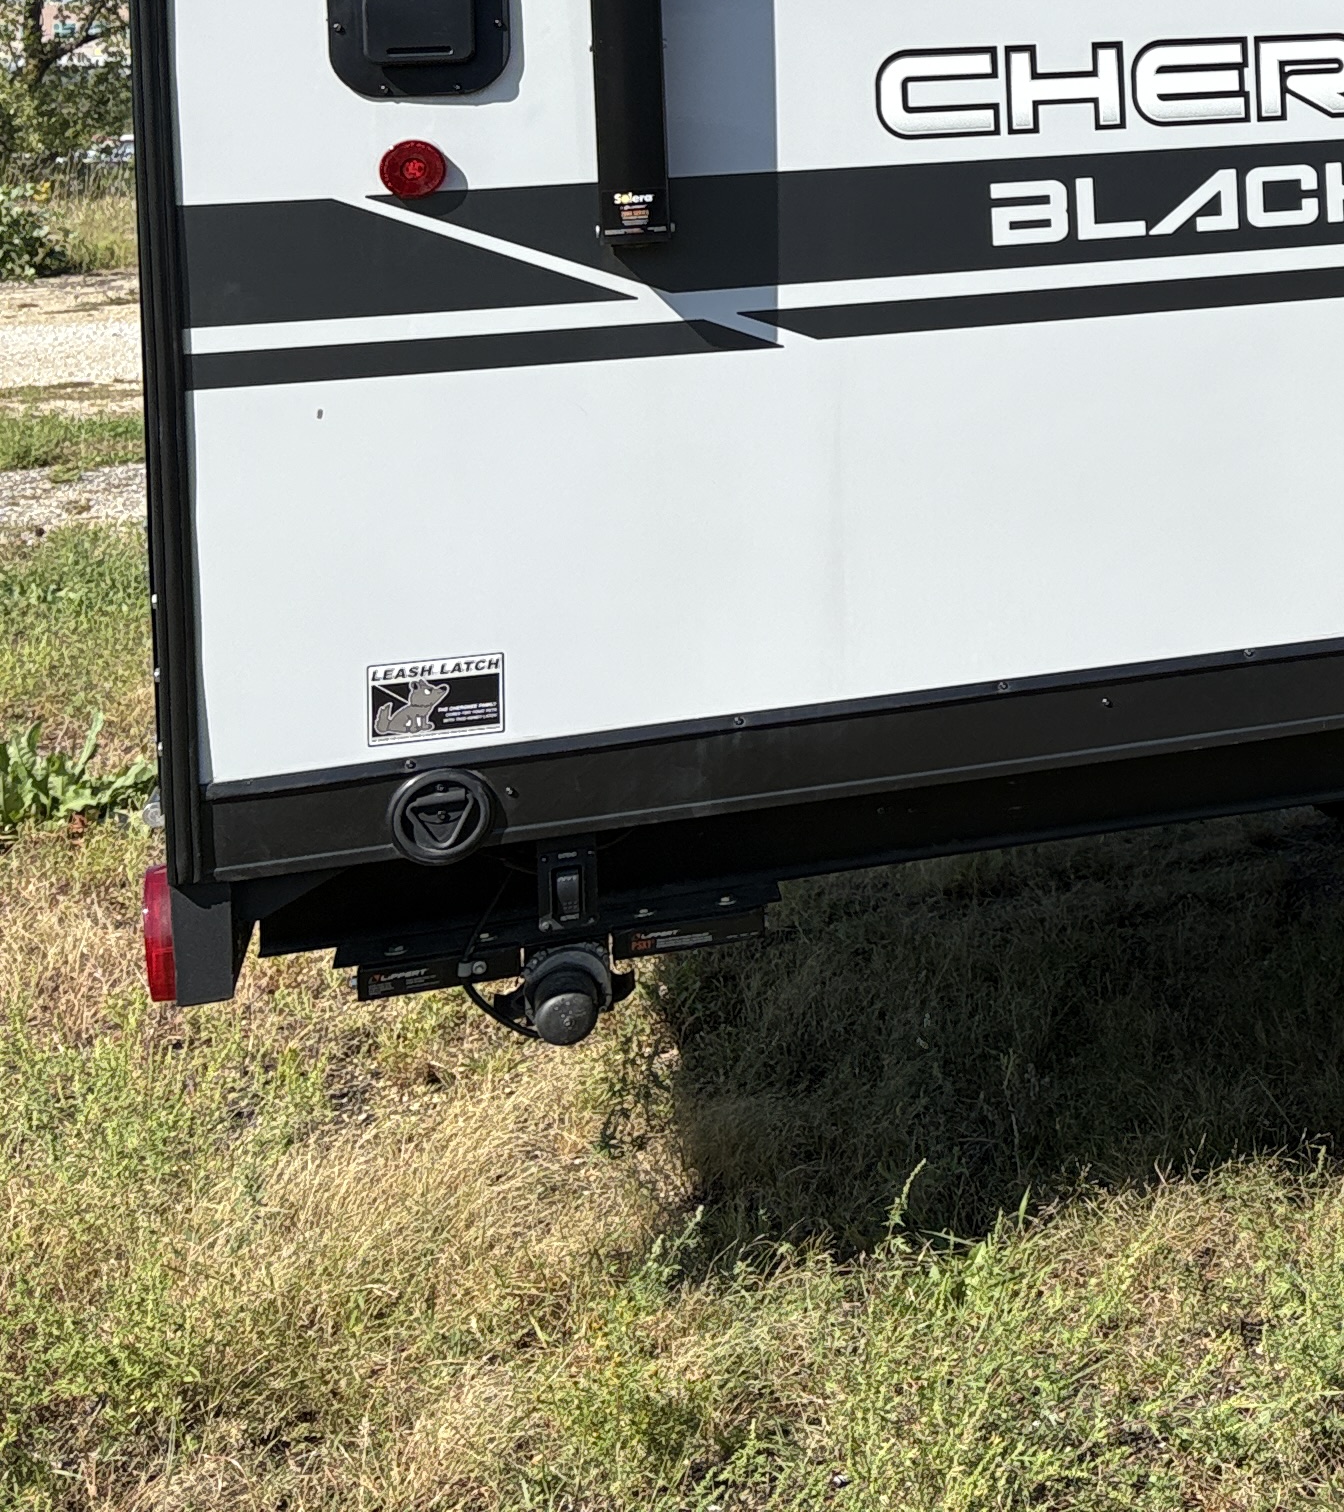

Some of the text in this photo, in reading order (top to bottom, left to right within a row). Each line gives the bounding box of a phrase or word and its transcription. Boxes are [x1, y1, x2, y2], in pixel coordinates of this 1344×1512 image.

[613, 191, 654, 205] Solera
[371, 657, 501, 683] LEASH LATCH
[380, 967, 430, 983] LIPPERT
